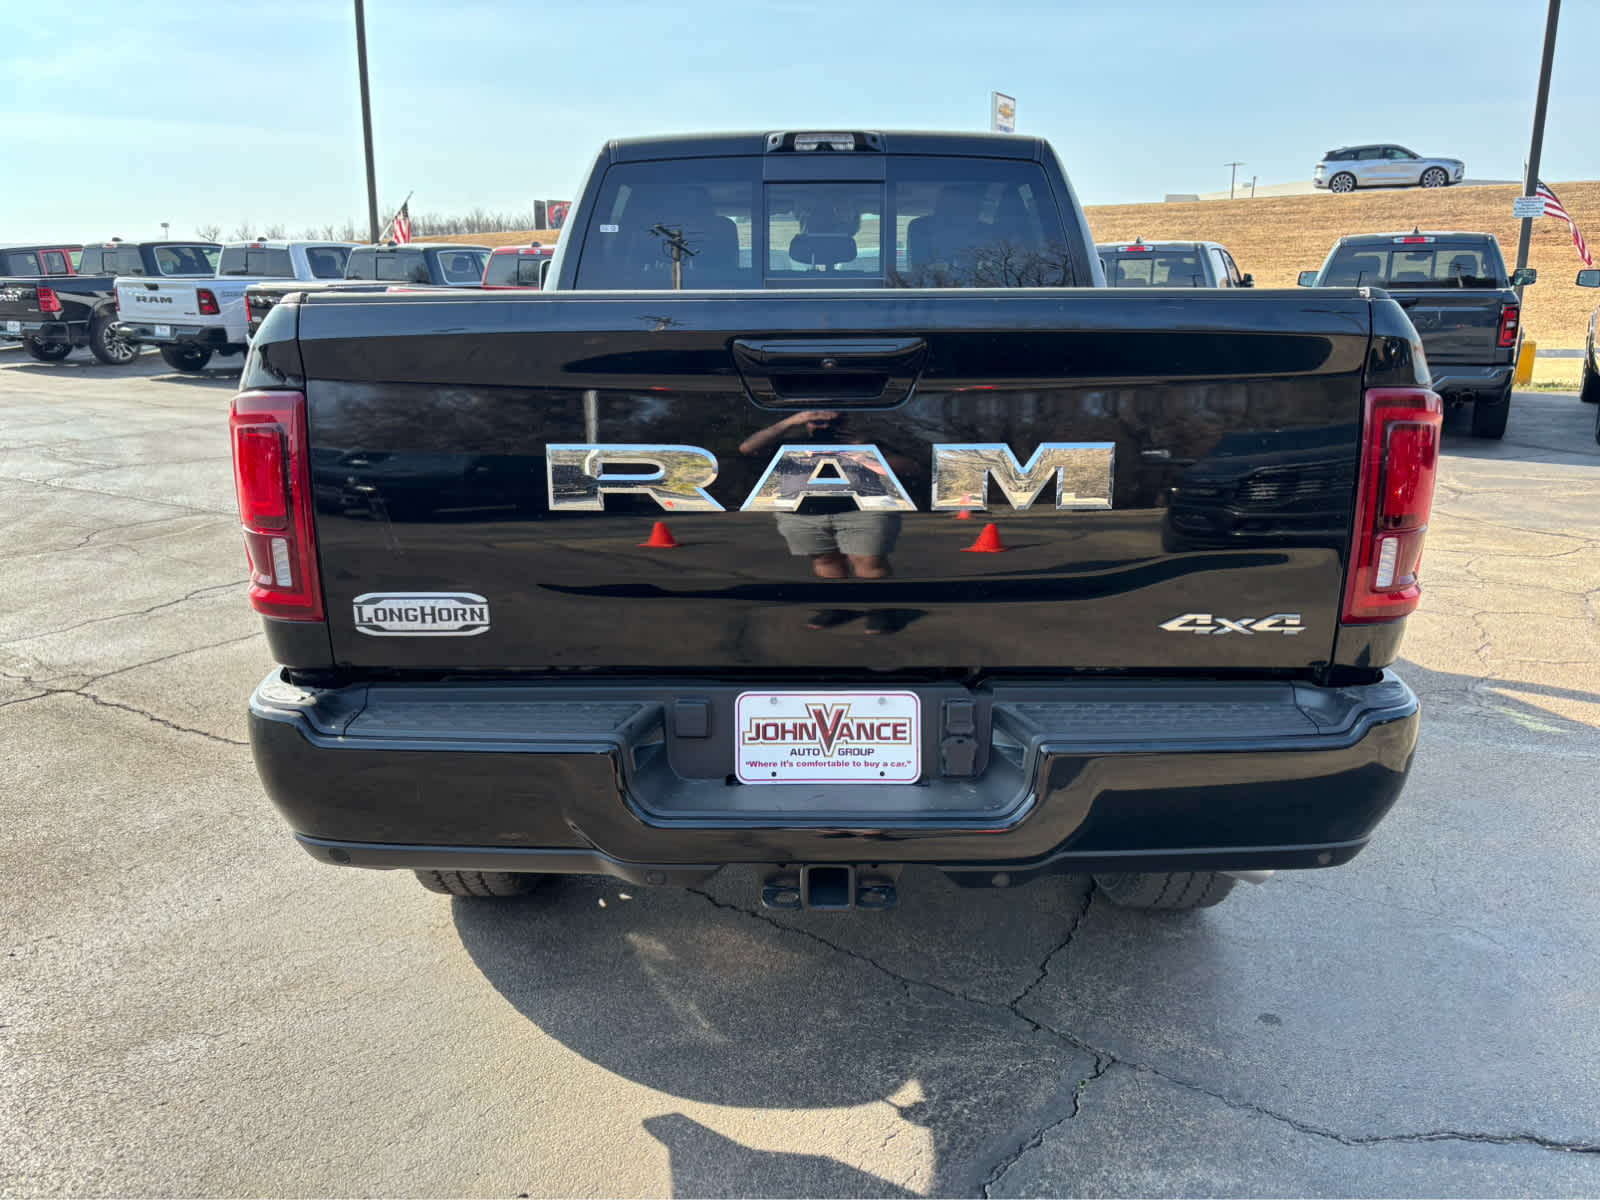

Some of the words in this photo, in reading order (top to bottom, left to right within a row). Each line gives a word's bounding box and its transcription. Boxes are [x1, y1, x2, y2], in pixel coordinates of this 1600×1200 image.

[136, 295, 173, 304] RAM
[546, 442, 1115, 511] RAM
[356, 605, 486, 624] LONGHORN
[748, 722, 817, 741] JOHN
[813, 708, 907, 753] VANCE
[790, 748, 820, 757] AUTO
[838, 748, 875, 757] GROUP
[796, 760, 850, 768] comfortable
[864, 760, 880, 769] buy
